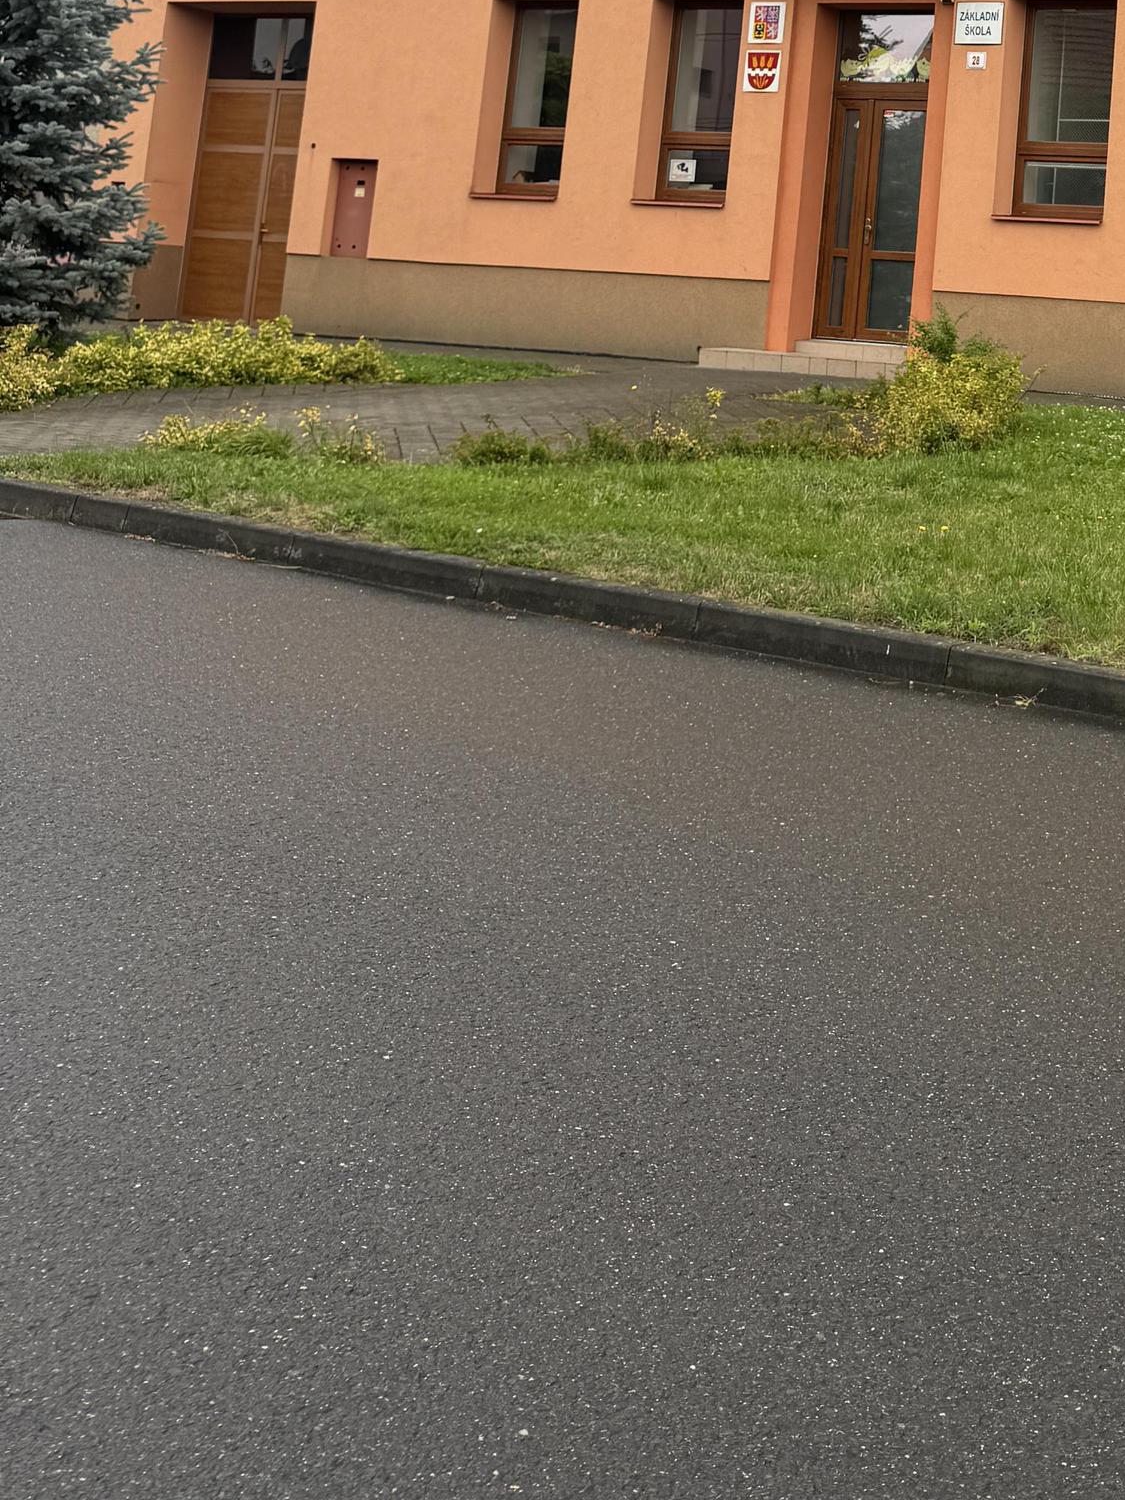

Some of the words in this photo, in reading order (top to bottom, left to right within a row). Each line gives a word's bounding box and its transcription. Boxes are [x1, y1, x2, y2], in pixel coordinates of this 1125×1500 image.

[960, 9, 999, 21] ZÁKLADNÍ
[965, 24, 991, 35] ŠKOLA
[972, 56, 980, 65] 28
